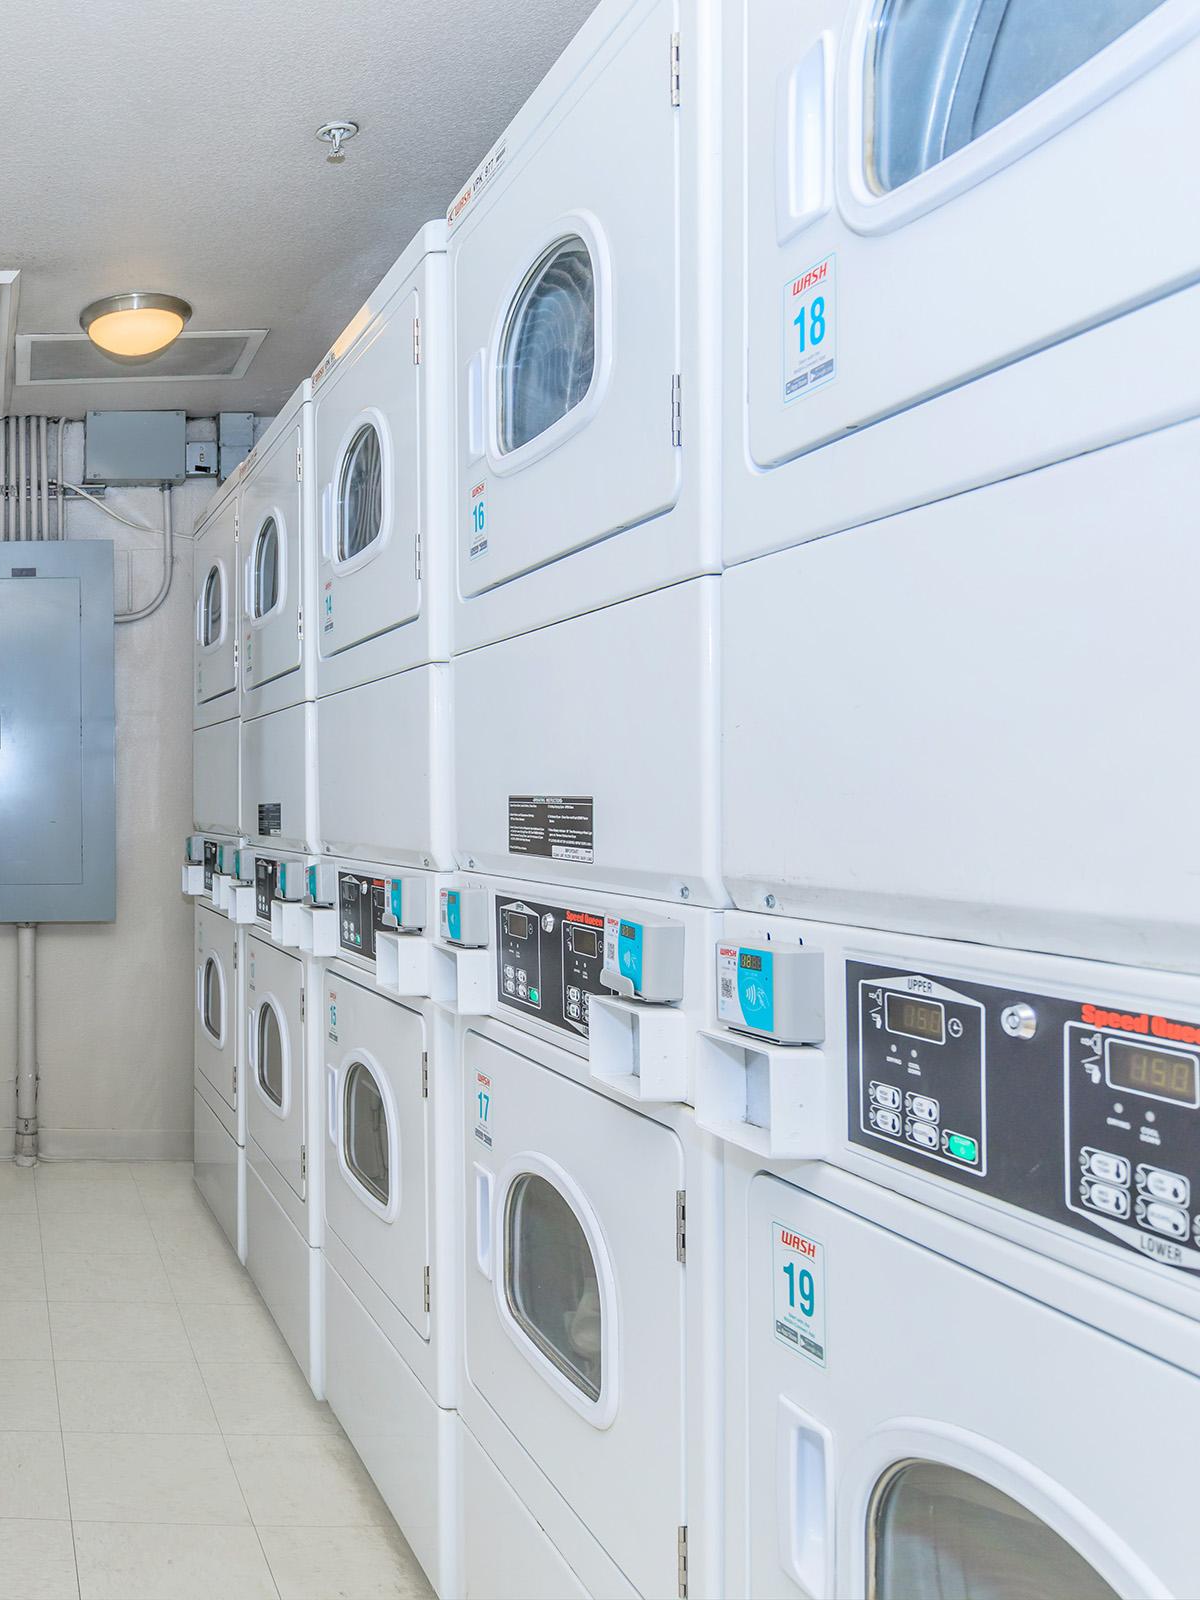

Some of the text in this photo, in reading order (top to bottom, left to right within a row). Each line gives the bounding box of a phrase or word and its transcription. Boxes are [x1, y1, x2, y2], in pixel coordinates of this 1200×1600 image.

[793, 262, 827, 296] WASH
[793, 296, 826, 353] 18
[473, 501, 485, 532] 16
[566, 910, 584, 924] Speed
[720, 948, 737, 957] WASH
[907, 978, 933, 993] UPPER
[1081, 1003, 1149, 1034] Speed
[478, 1091, 490, 1121] 17
[781, 1230, 816, 1258] WASH
[1140, 1235, 1182, 1262] LOWER
[783, 1262, 815, 1317] 19
